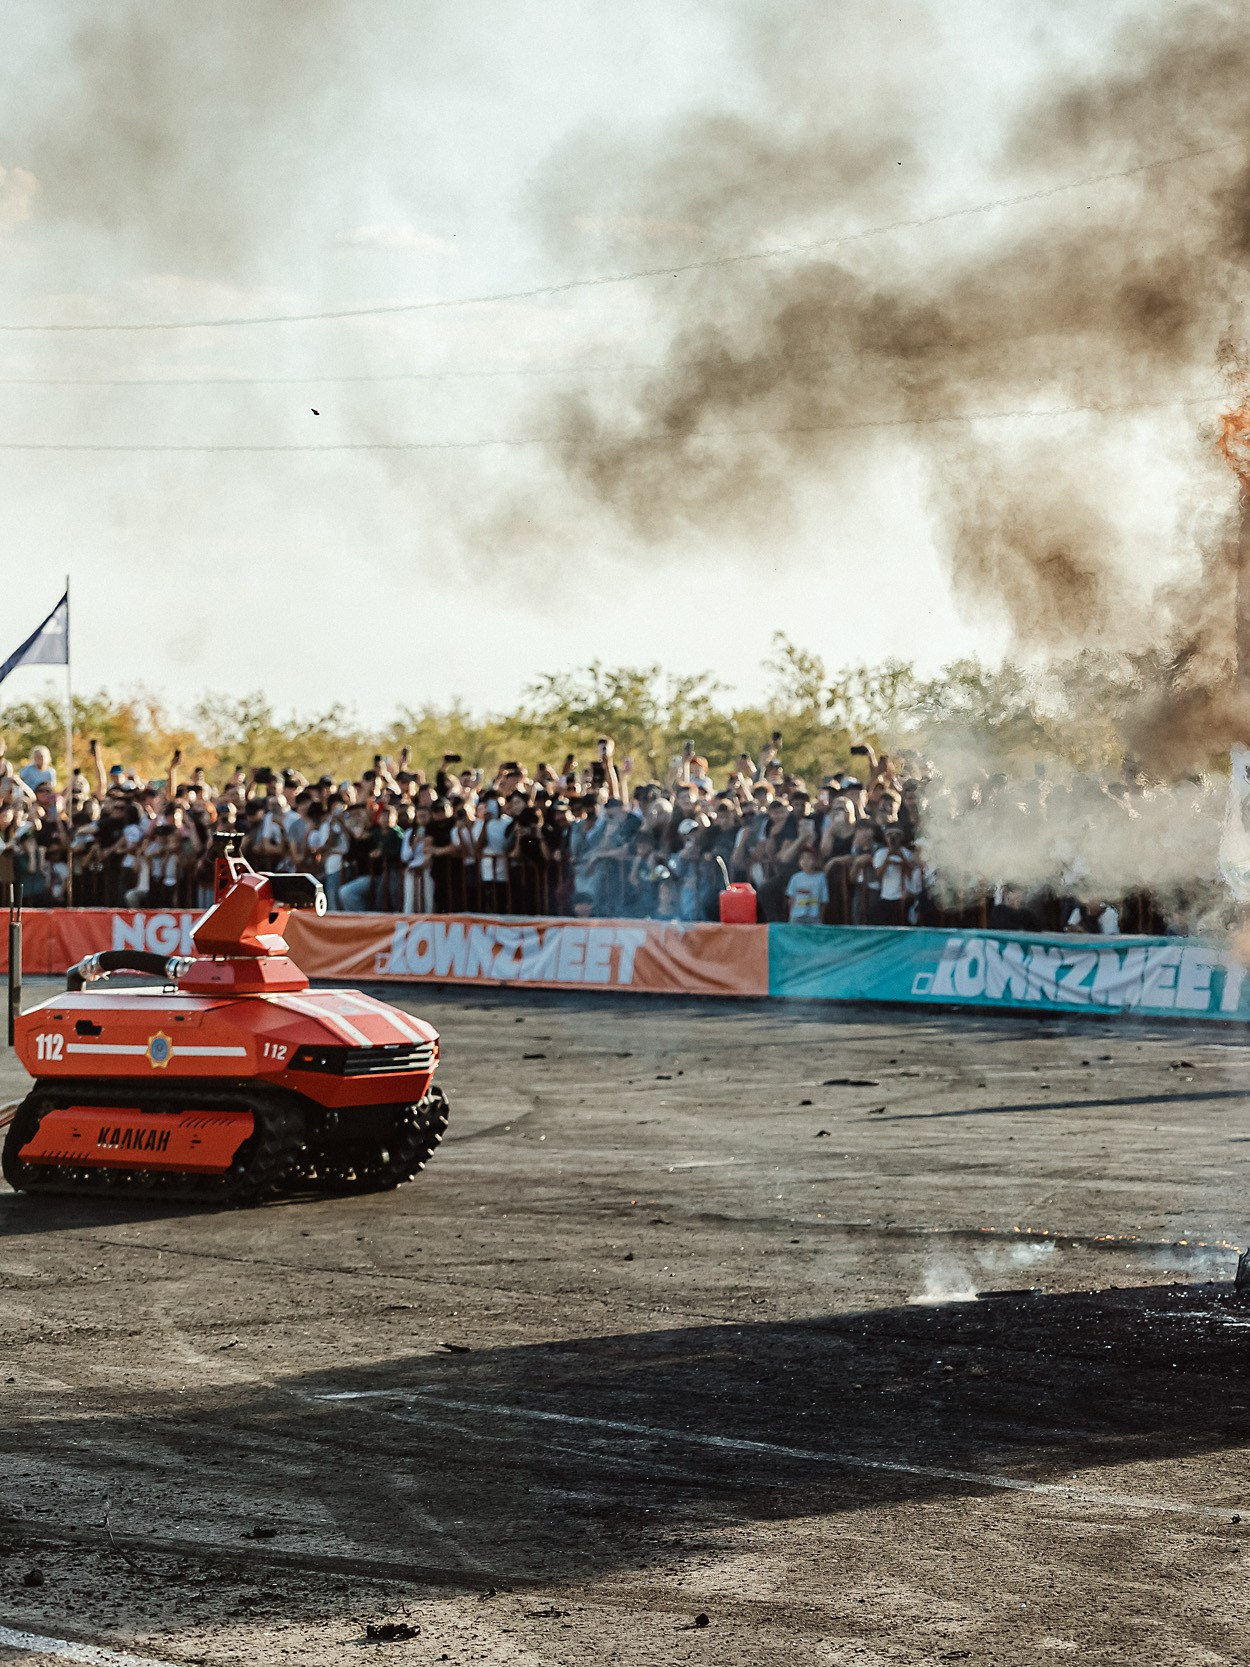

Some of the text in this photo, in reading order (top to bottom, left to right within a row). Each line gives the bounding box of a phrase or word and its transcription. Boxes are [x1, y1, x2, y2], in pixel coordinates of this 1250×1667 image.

[35, 1033, 65, 1061] 112
[263, 1042, 288, 1060] 112
[96, 1127, 172, 1152] КАЛКАН
